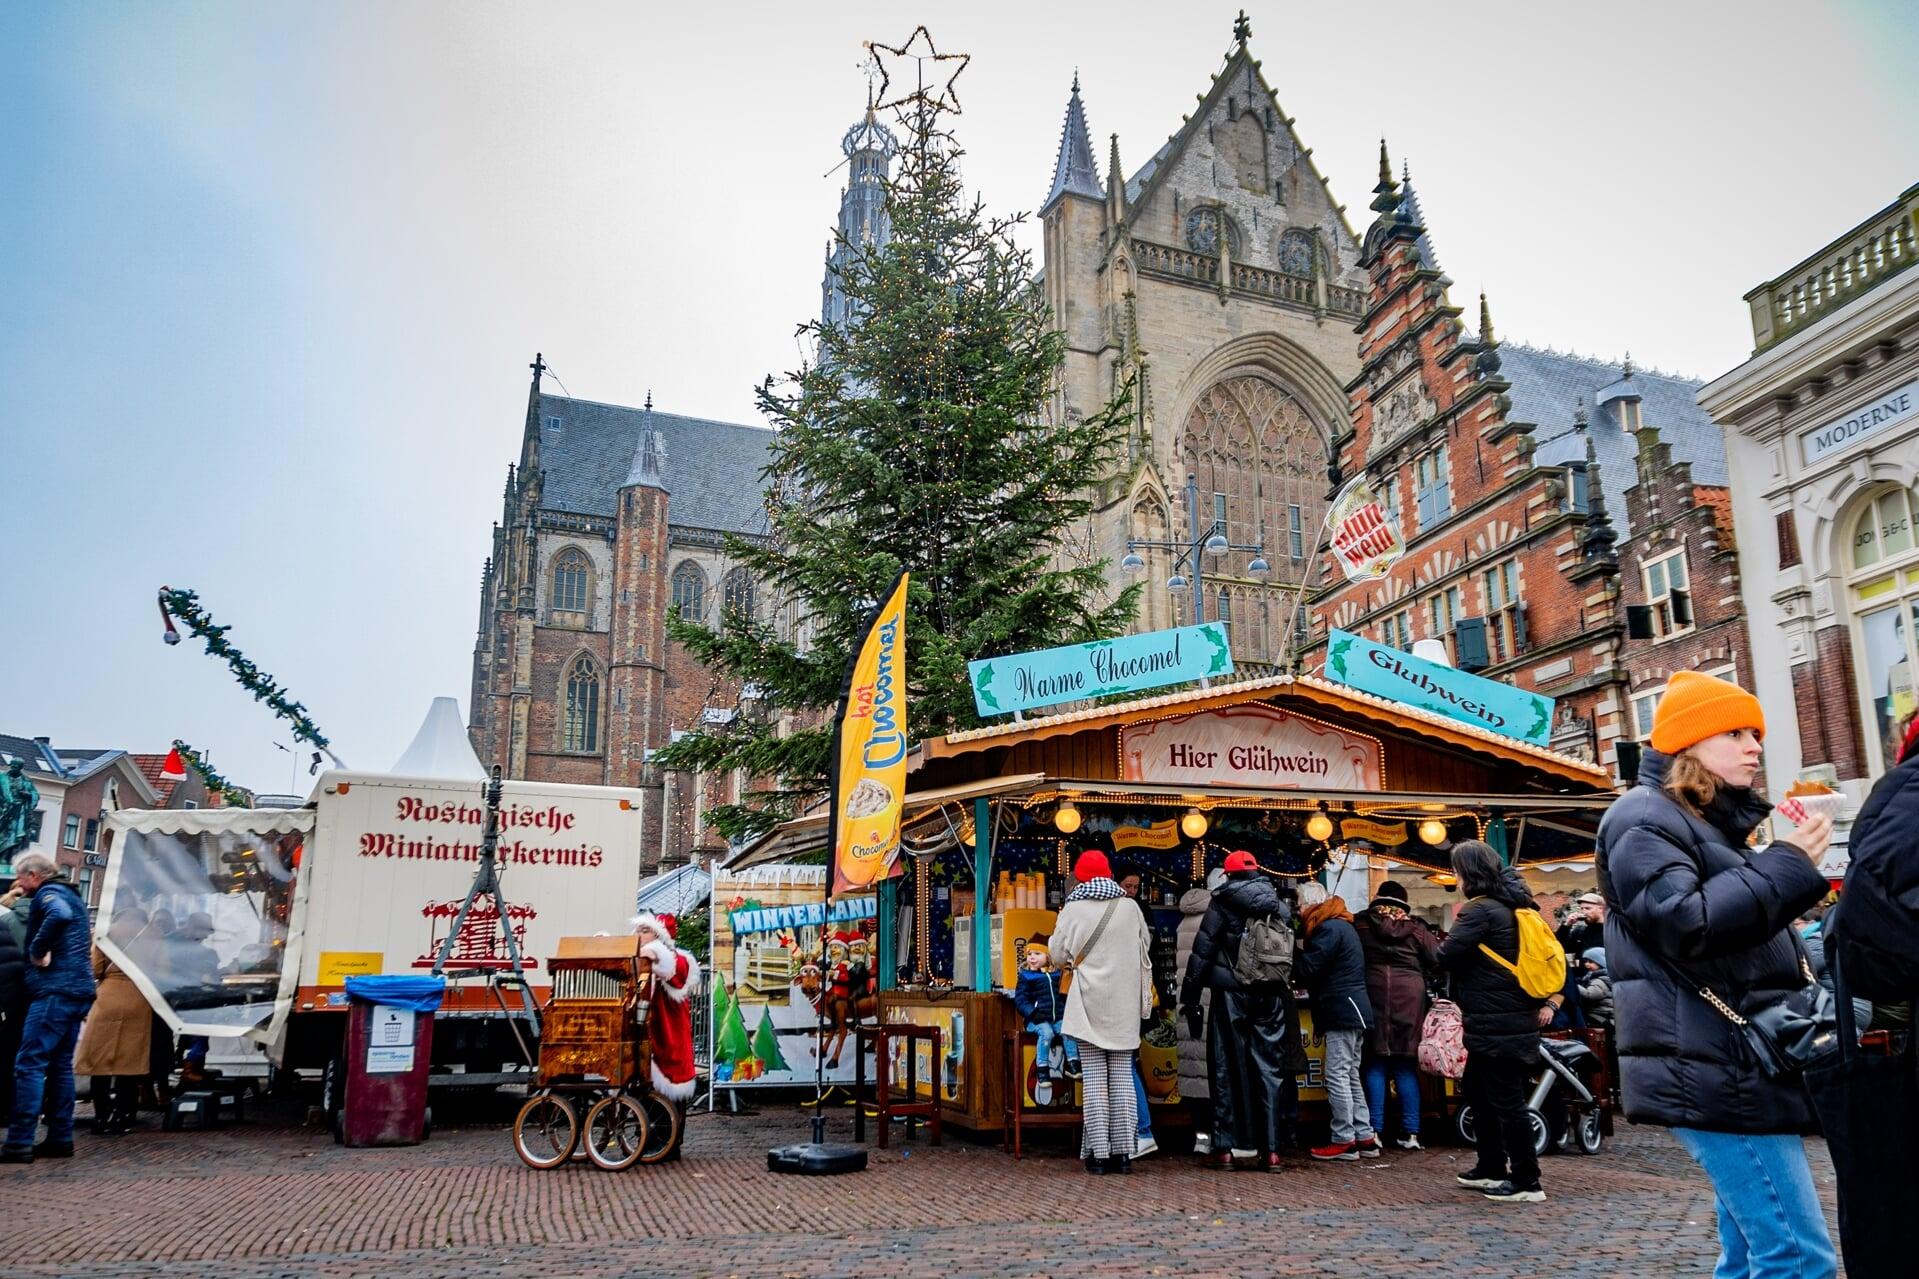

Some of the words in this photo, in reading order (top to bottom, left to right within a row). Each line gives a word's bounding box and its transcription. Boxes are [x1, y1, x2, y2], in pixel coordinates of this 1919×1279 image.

[1815, 393, 1911, 452] MODERNE
[863, 613, 907, 769] Chocomel
[1014, 666, 1086, 703] Warme
[1090, 633, 1182, 684] Chocomel
[1368, 649, 1506, 728] Gluhwein
[851, 682, 875, 718] hot
[1170, 743, 1217, 769] Hier
[1228, 745, 1328, 777] Glühwein
[396, 796, 576, 835] Nostagische
[358, 833, 602, 868] Miniaturkermis
